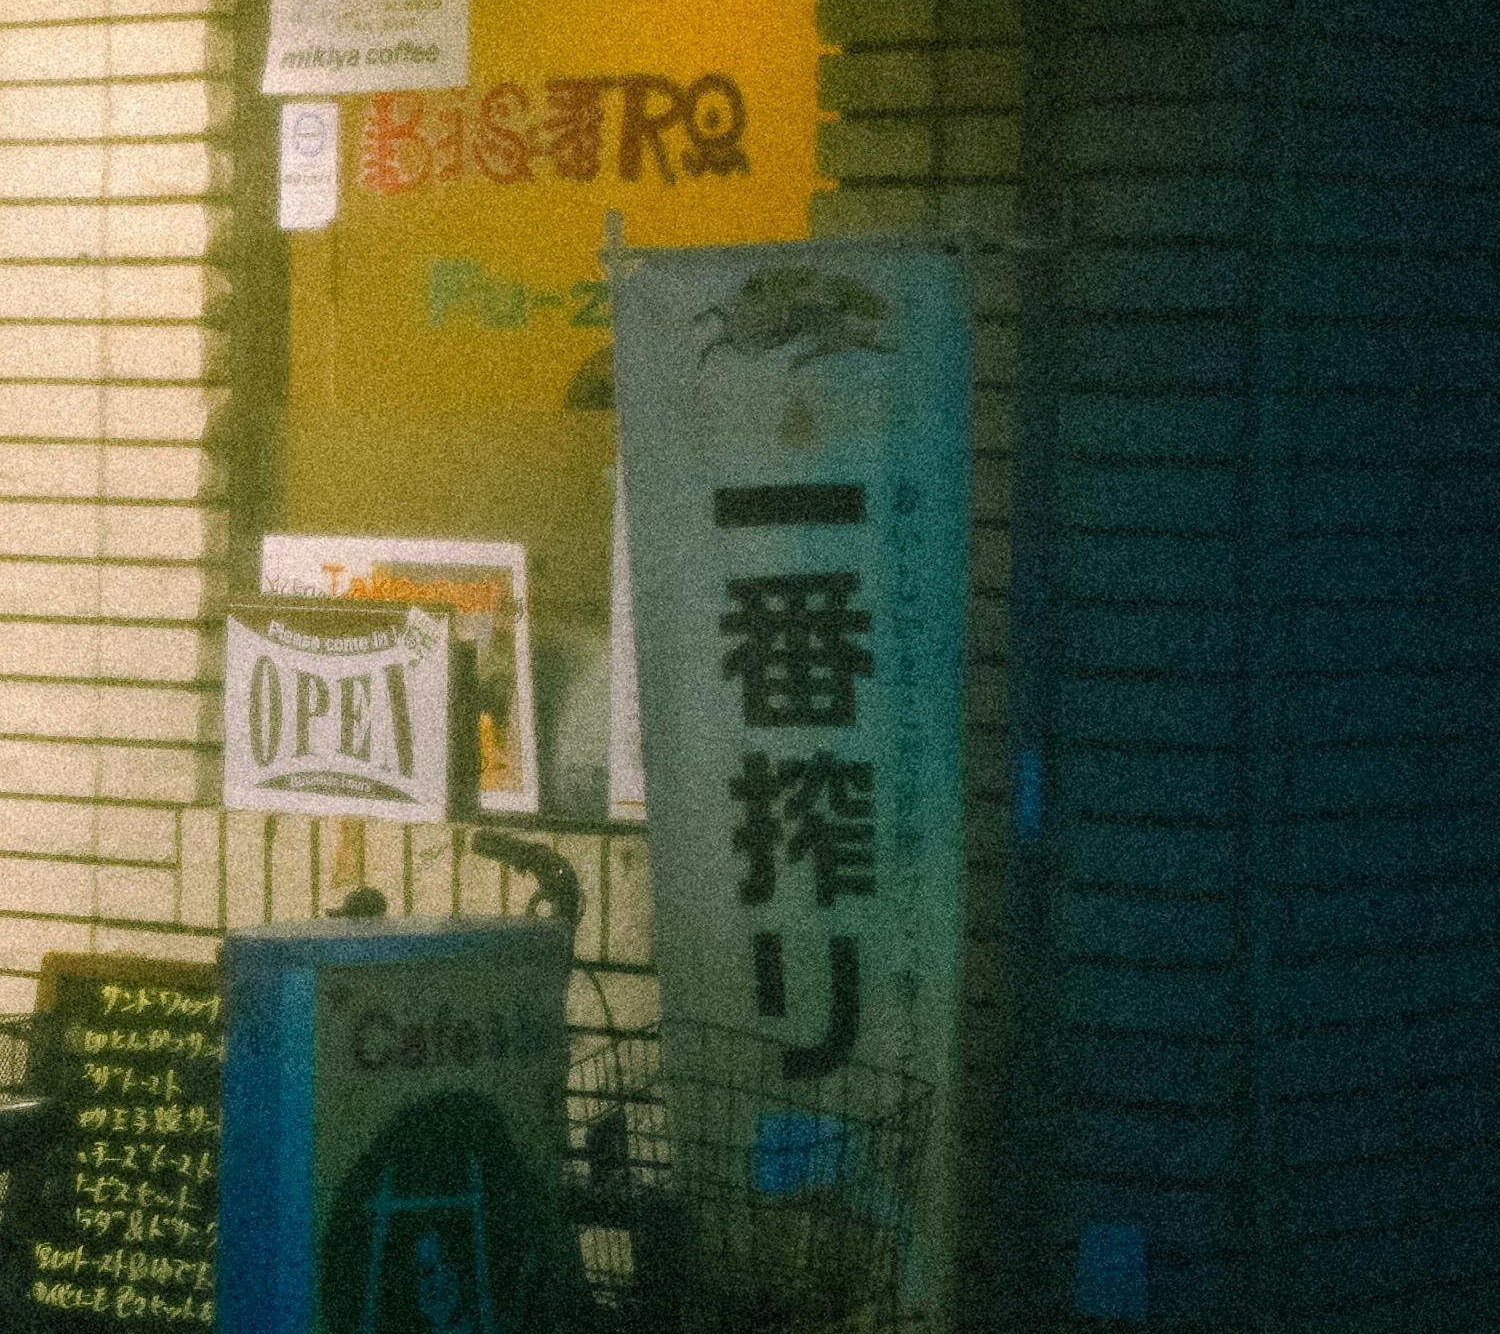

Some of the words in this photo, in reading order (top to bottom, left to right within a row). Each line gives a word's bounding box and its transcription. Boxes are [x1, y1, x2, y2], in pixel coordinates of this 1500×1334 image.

[366, 40, 442, 66] coffee
[267, 620, 321, 651] Please
[325, 636, 370, 653] come
[371, 630, 388, 650] in
[713, 481, 877, 1081] 一番搾り
